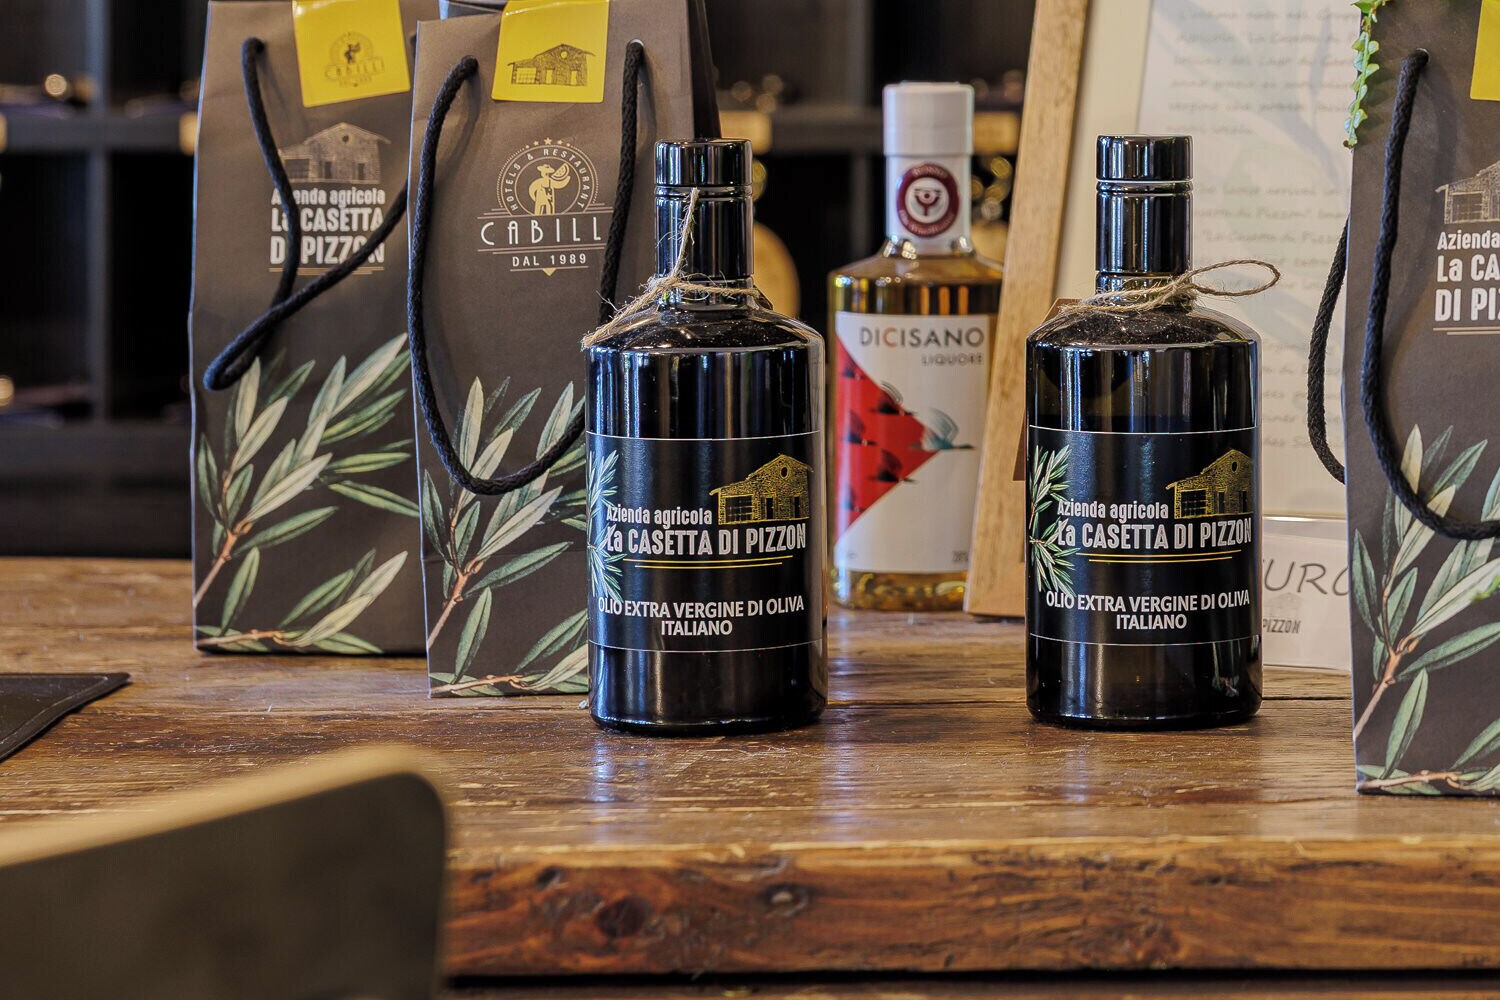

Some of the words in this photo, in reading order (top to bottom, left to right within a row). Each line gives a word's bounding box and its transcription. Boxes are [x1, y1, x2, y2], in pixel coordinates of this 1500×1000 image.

[505, 163, 521, 211] HOTELS
[543, 148, 590, 208] RESTAURANT
[271, 187, 327, 205] Aenda
[329, 186, 386, 208] agricola
[300, 207, 384, 232] CASETTA
[480, 216, 602, 246] CABILL
[1437, 230, 1500, 251] Azienda
[512, 256, 540, 267] DAL
[550, 253, 587, 265] 1989
[1437, 255, 1463, 283] La
[1434, 288, 1461, 322] DI
[860, 327, 985, 348] DICISANO
[606, 504, 650, 525] Azienda
[654, 506, 713, 530] agricola
[1057, 500, 1106, 519] Azienda
[1110, 500, 1169, 524] agricola
[606, 525, 623, 552] La
[628, 529, 713, 555] CASETTA
[718, 530, 739, 555] DI
[746, 523, 806, 552] PIZZON
[1058, 522, 1076, 547] La
[1082, 523, 1169, 549] CASETTA
[1173, 523, 1194, 549] DI
[1200, 518, 1252, 548] PIZZON
[598, 597, 623, 615] OLIO
[625, 602, 670, 618] EXTRA
[673, 602, 744, 618] VERGINE
[747, 600, 763, 616] DI
[766, 595, 804, 614] OLIVA
[1046, 591, 1075, 609] OLIO
[1077, 595, 1126, 612] EXTRA
[1129, 594, 1198, 612] VERGINE
[1200, 593, 1216, 610] DI
[1217, 589, 1251, 609] OLIVA
[661, 620, 733, 636] ITALIANO
[1116, 613, 1188, 630] ITALIANO
